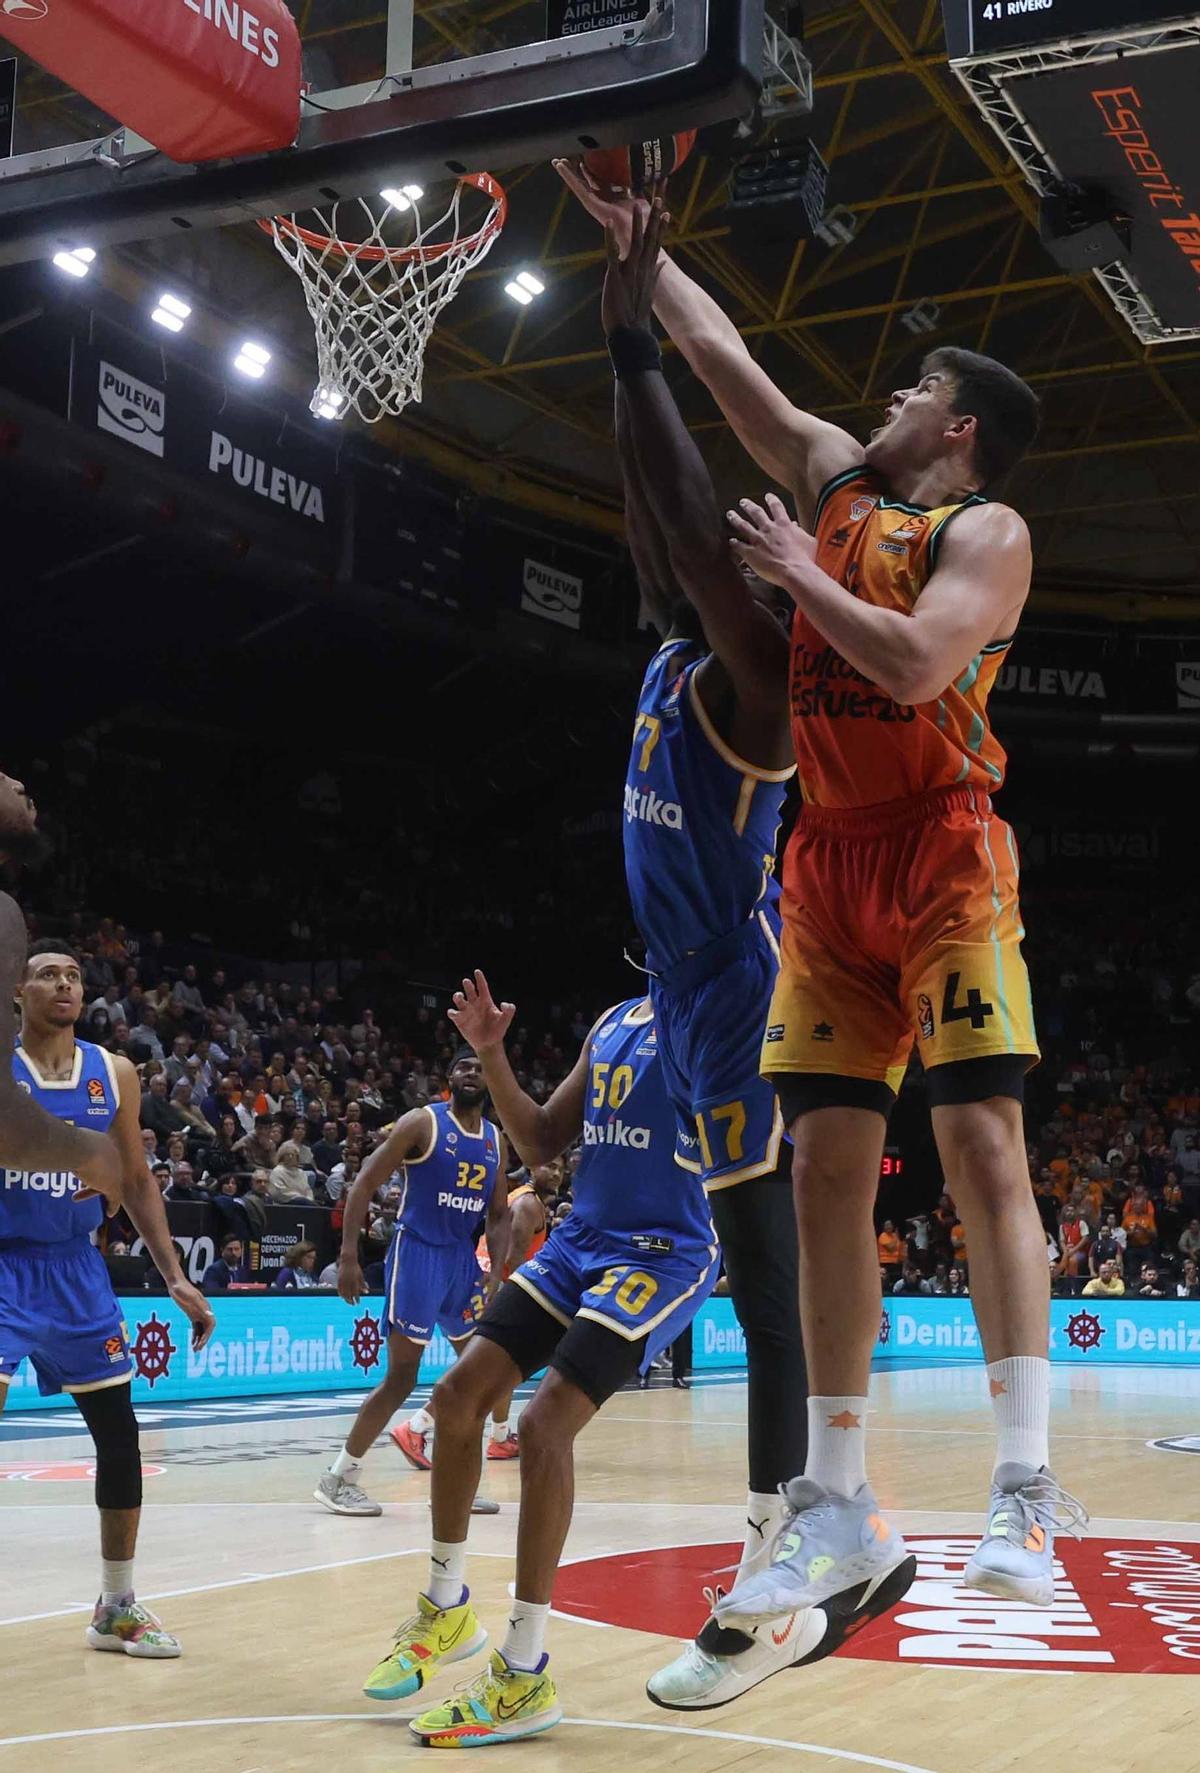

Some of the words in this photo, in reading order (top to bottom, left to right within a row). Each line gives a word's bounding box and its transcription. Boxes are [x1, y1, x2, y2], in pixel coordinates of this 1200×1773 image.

[561, 10, 639, 34] EuroLeague
[983, 2, 1002, 20] 41
[1007, 0, 1053, 15] RIVERO
[1091, 86, 1184, 208] Esperit
[103, 371, 161, 417] PULEVA
[209, 431, 324, 522] PULEVA
[527, 566, 579, 598] PULEVA
[995, 665, 1106, 699] ULEVA
[624, 784, 683, 831] ytika
[941, 971, 994, 1029] 4
[592, 1063, 633, 1109] 50
[695, 1101, 746, 1168] 17
[5, 1168, 88, 1198] Playt
[456, 1162, 486, 1190] 32
[882, 1158, 901, 1175] 31
[438, 1192, 486, 1213] Playtik
[186, 1325, 342, 1379] DenizBank
[704, 1319, 747, 1355] Deniz
[1116, 1318, 1200, 1352] Deniz
